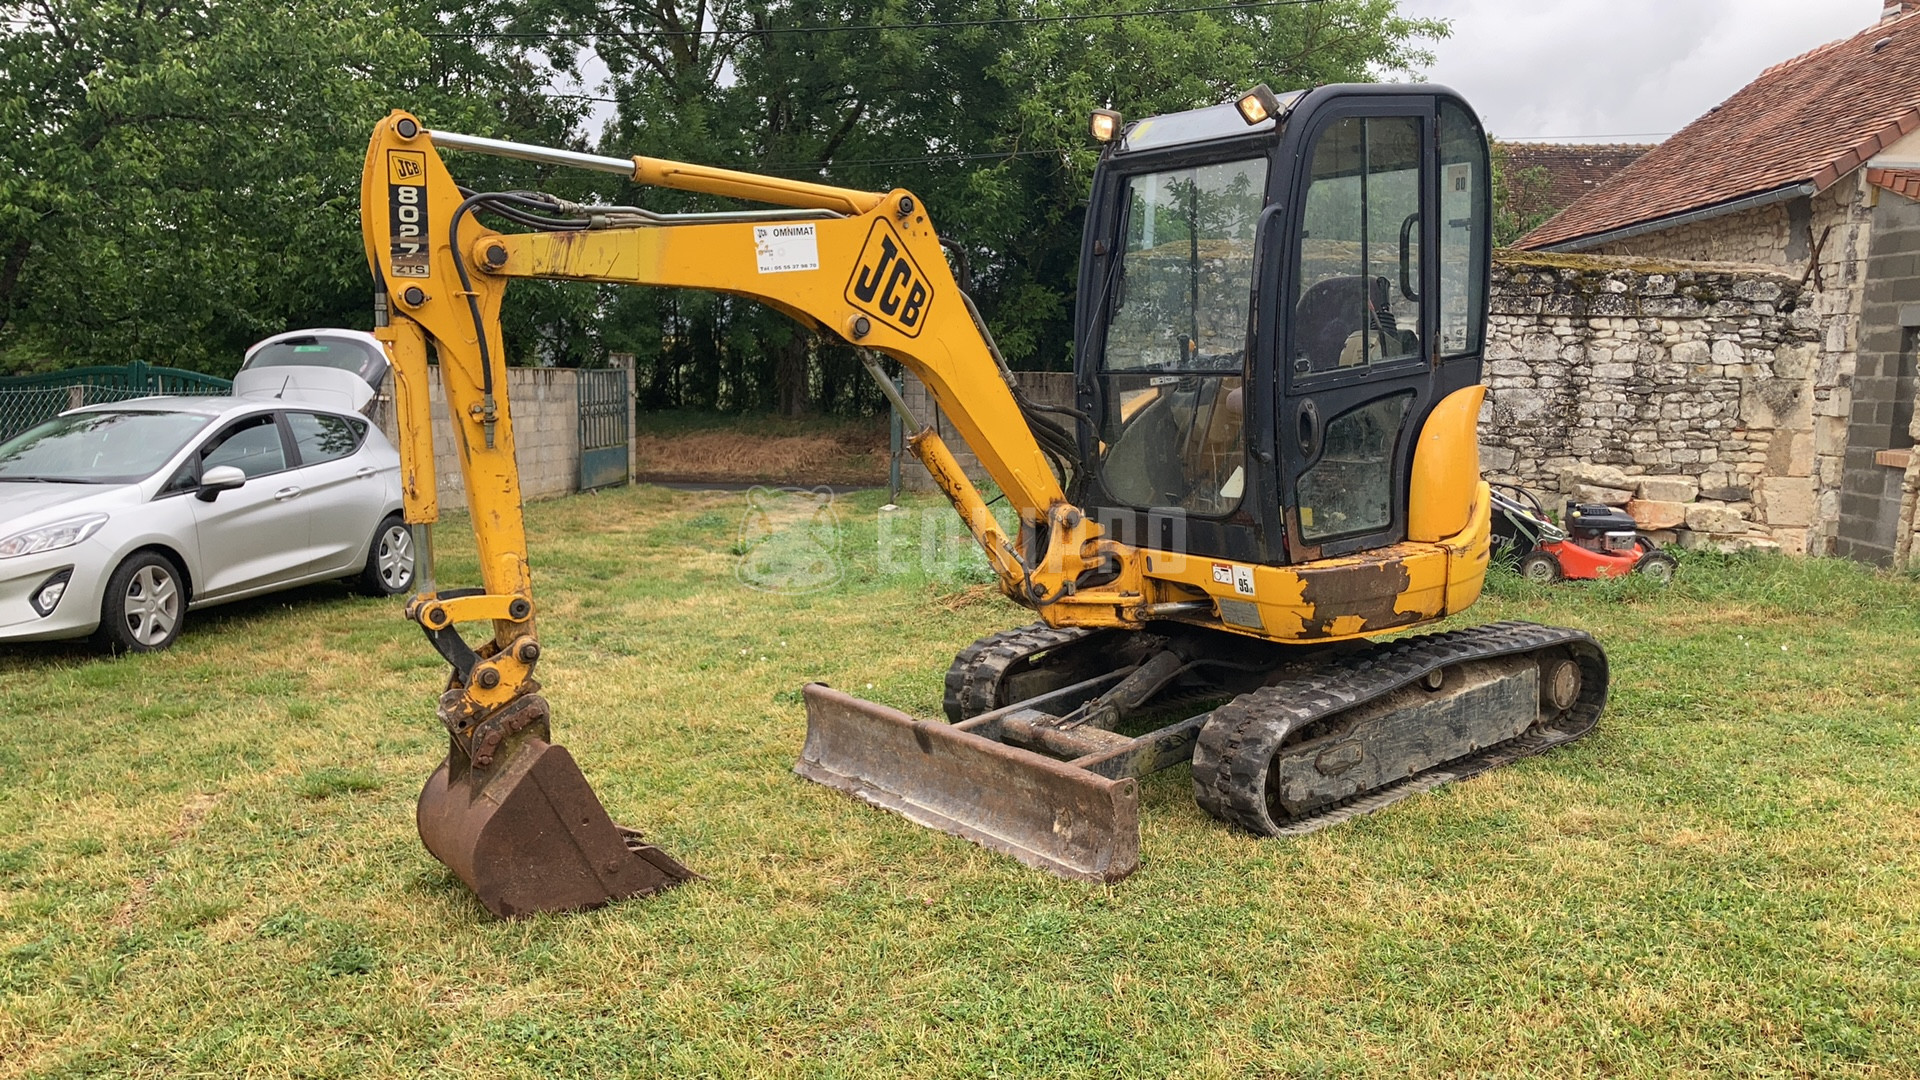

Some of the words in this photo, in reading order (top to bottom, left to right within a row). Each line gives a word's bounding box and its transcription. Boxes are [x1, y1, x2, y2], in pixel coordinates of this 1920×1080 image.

[397, 159, 420, 178] JCB
[398, 186, 420, 258] 8027
[773, 226, 814, 237] OMNIMAT
[395, 264, 426, 274] ZTS
[854, 233, 927, 327] JCB
[1238, 578, 1249, 593] 95
